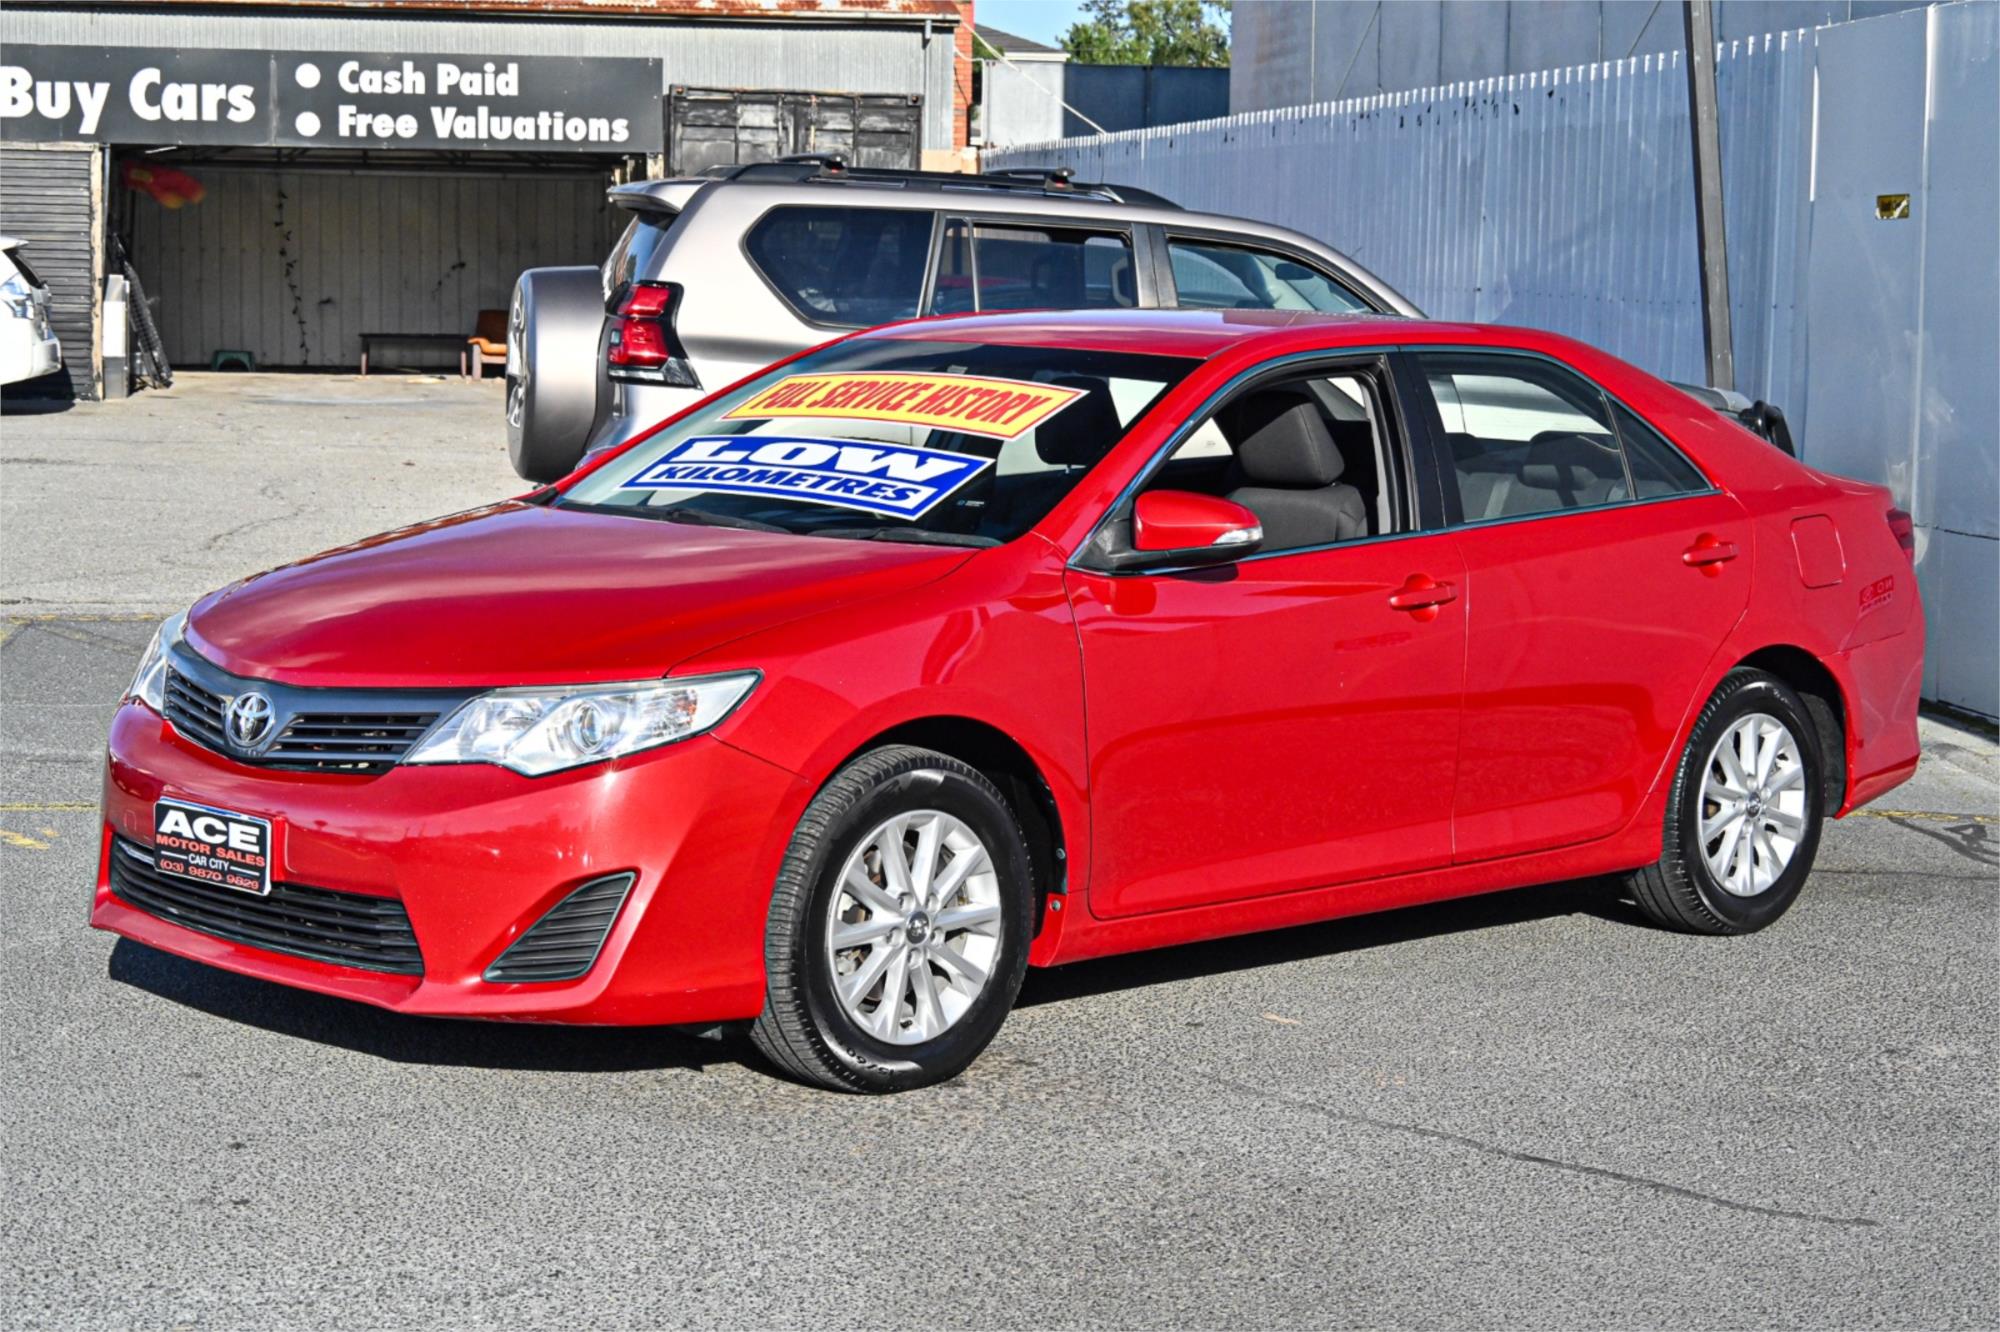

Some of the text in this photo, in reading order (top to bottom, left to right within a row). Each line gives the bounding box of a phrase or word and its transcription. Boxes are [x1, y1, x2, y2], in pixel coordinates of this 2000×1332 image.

[338, 61, 519, 97] Cash Paid
[0, 66, 256, 135] Buy Cars
[338, 104, 629, 143] Free Valuations
[749, 380, 1053, 426] FULL SERVICE HISTORY
[669, 440, 969, 482] LOW
[651, 465, 919, 502] KILOMETRES
[158, 809, 260, 853] ACE
[155, 834, 266, 867] MOTOR SALES
[188, 853, 230, 871] CAR CITY
[159, 859, 260, 890] (03) 9870 9829
